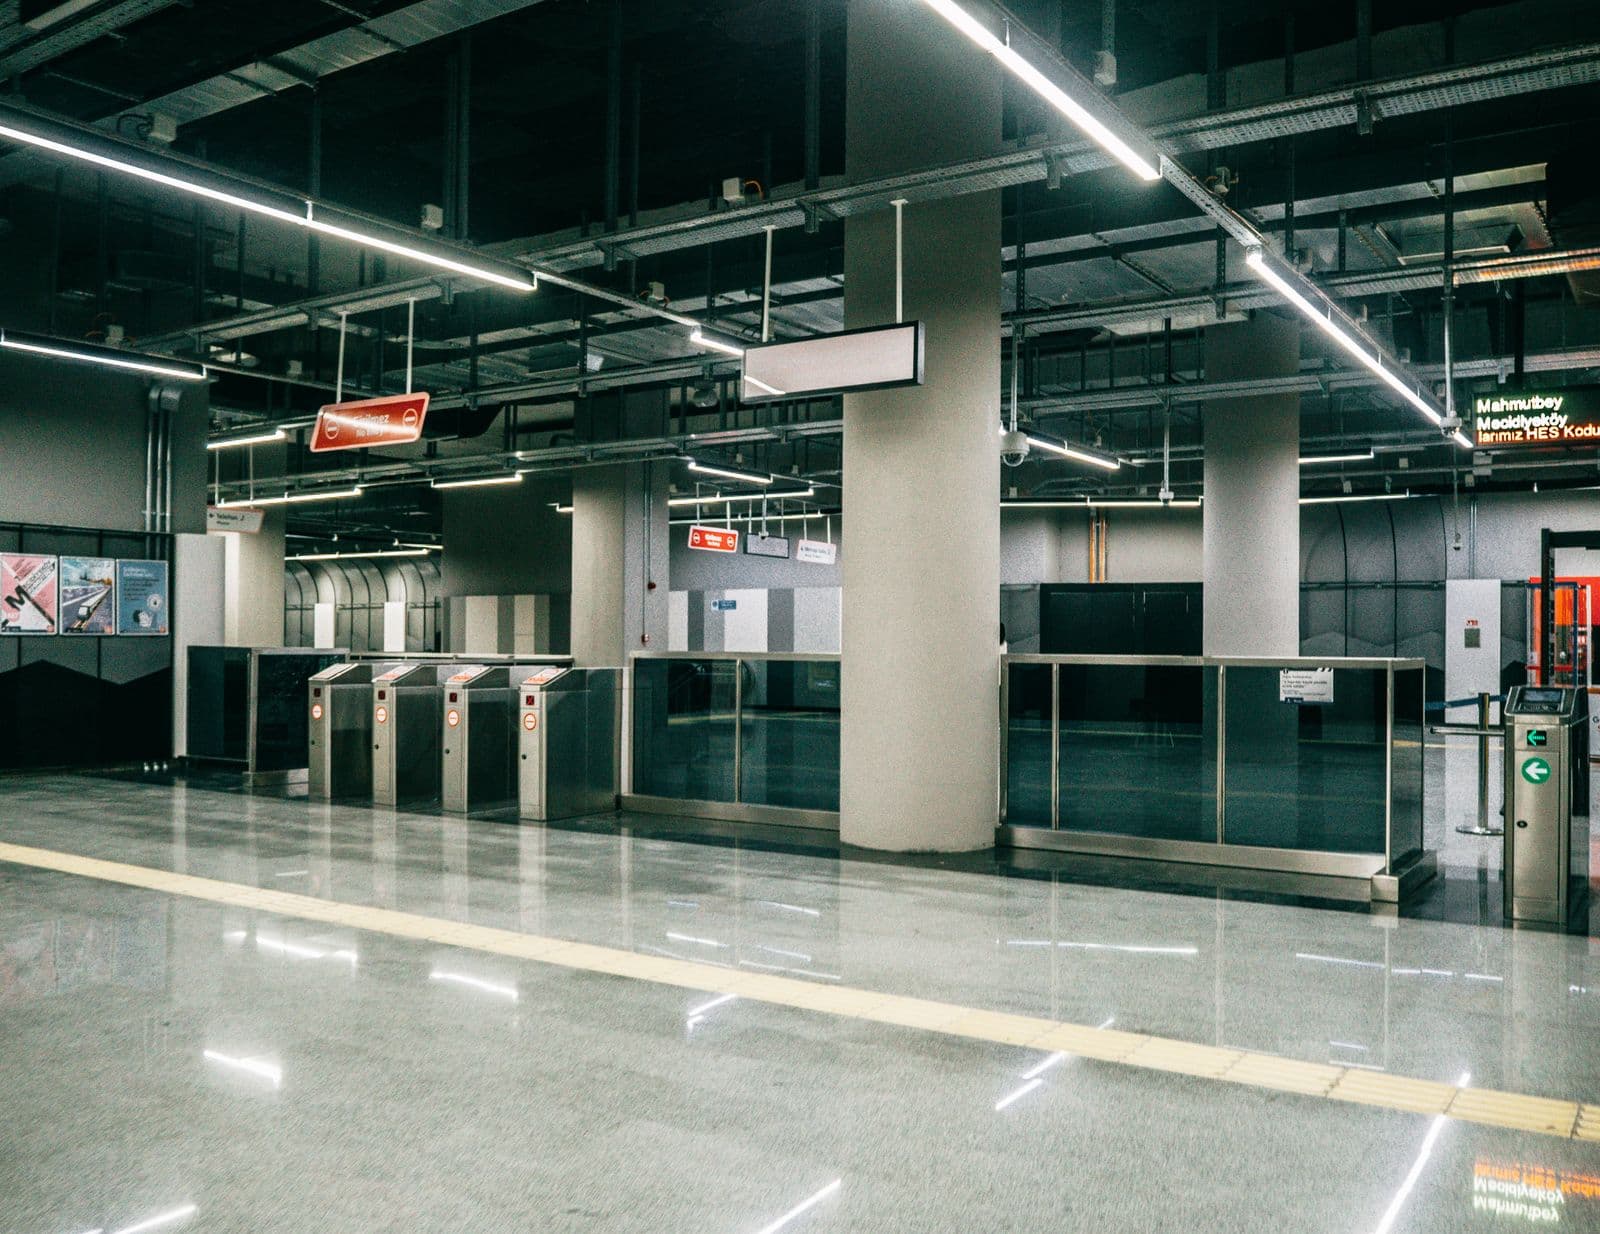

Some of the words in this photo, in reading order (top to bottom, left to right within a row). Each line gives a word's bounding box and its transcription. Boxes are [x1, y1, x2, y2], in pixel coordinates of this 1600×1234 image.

[1477, 396, 1563, 413] Mahmutbey
[1526, 426, 1560, 440] HES
[1564, 423, 1600, 438] Kodu
